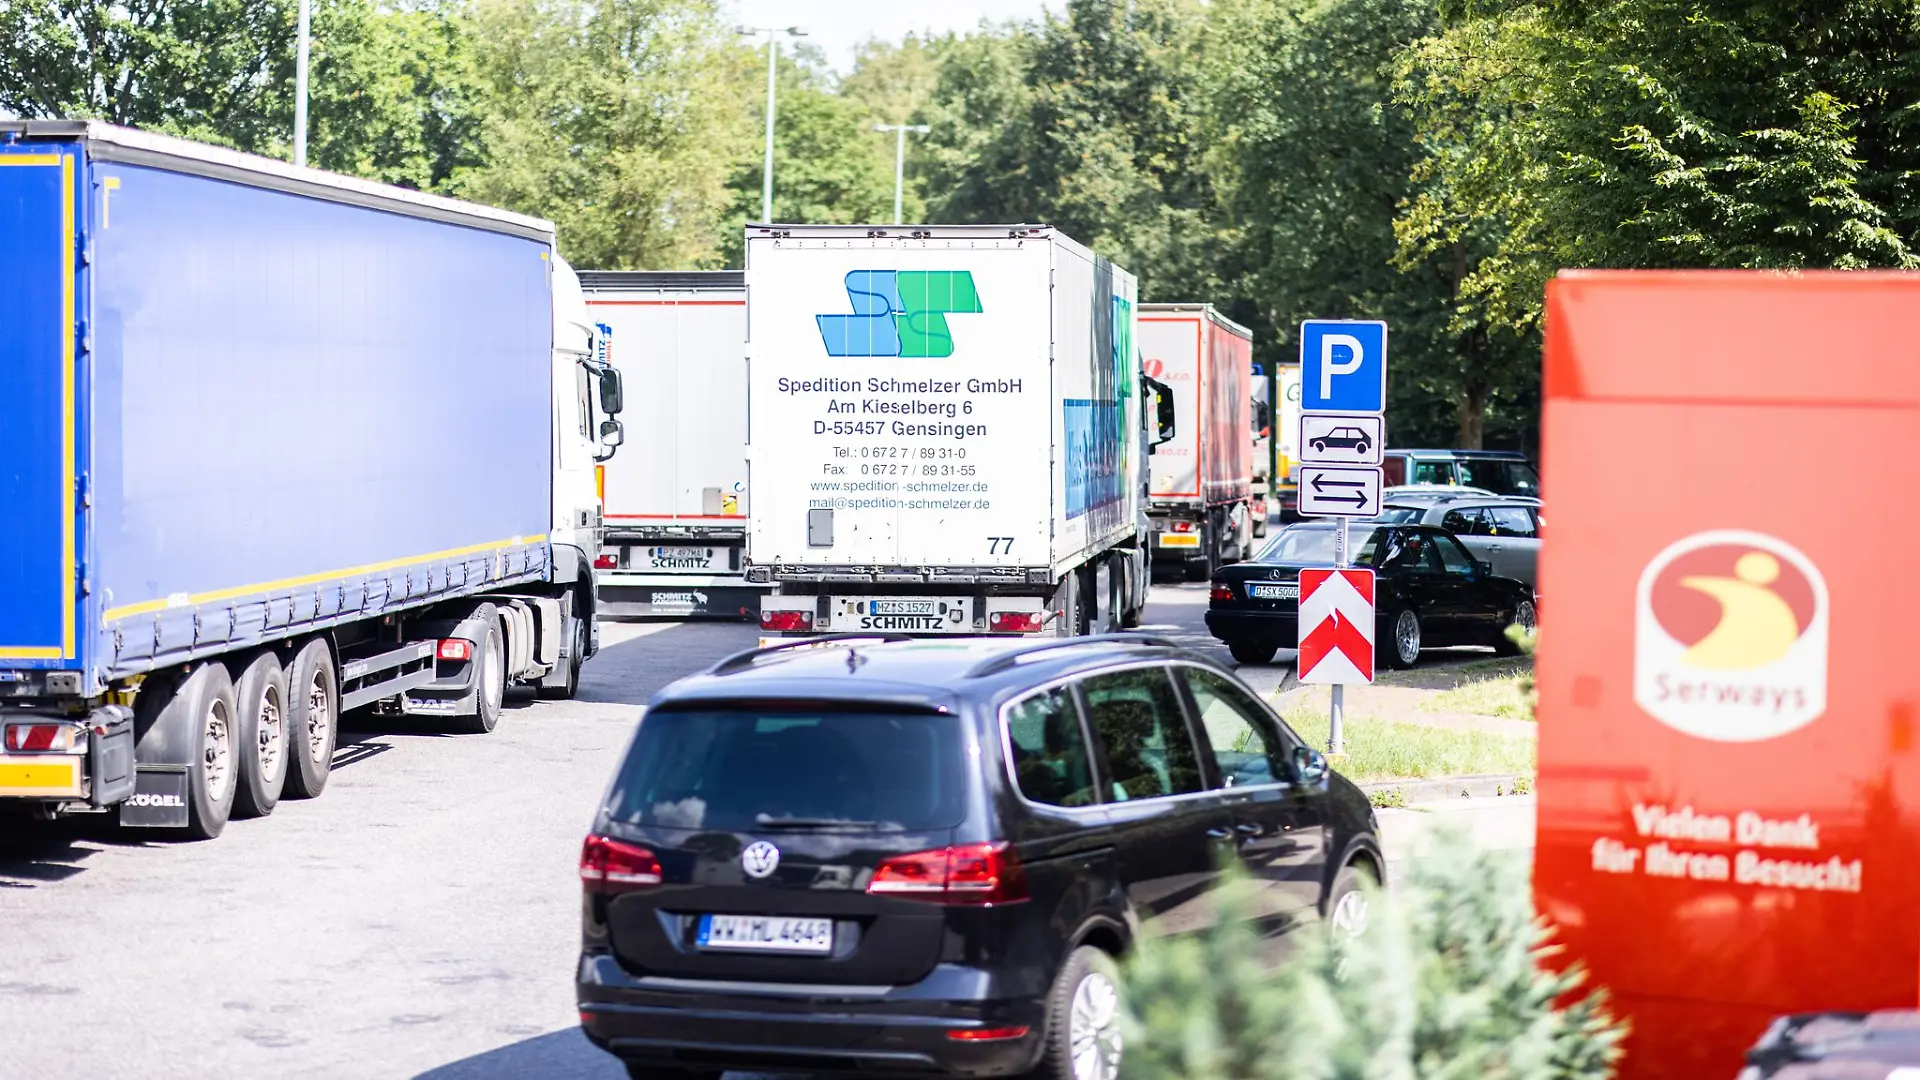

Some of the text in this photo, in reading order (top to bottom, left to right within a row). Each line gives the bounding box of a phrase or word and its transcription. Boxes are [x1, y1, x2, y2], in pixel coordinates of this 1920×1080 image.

[1320, 334, 1364, 400] P
[778, 377, 1022, 395] Spedition Schmelzer GmbH
[828, 399, 973, 418] Am Kieselberg 6
[814, 421, 987, 439] D-55457 Gensingen
[833, 447, 857, 458] Tel.:
[861, 447, 869, 458] 0
[920, 448, 935, 459] 89
[939, 448, 966, 459] 31-0
[823, 464, 848, 475] Fax:
[861, 464, 869, 475] 0
[922, 465, 937, 476] 89
[941, 465, 976, 476] 31-55
[809, 497, 990, 509] mail@spedition-schmelzer.de
[987, 537, 1015, 555] 77
[651, 558, 710, 568] SCHMITZ
[906, 602, 931, 612] 1527
[861, 617, 943, 629] SCHMITZ
[1654, 671, 1807, 714] Serways
[1632, 803, 1819, 849] Vielen Dank
[1591, 837, 1862, 893] für Ihren Besuch!
